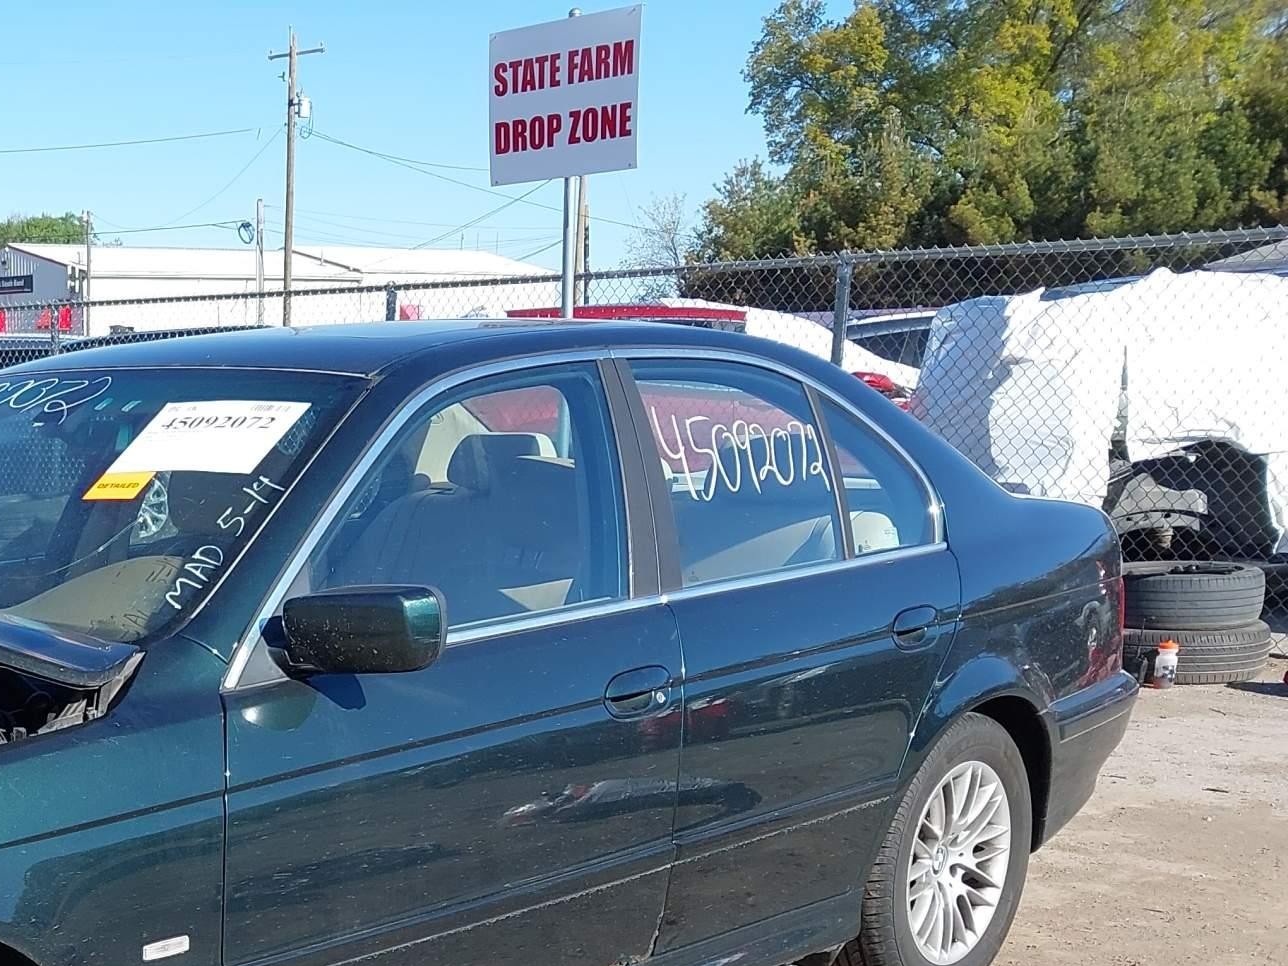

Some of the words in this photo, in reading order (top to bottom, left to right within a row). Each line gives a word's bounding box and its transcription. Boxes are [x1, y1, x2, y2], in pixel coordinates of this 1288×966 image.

[494, 53, 561, 97] STATE
[568, 40, 634, 84] FARM
[495, 114, 562, 155] DROP
[568, 102, 632, 145] ZONE
[161, 416, 277, 430] 45092072
[651, 406, 831, 501] 45092072
[165, 545, 224, 609] MAD
